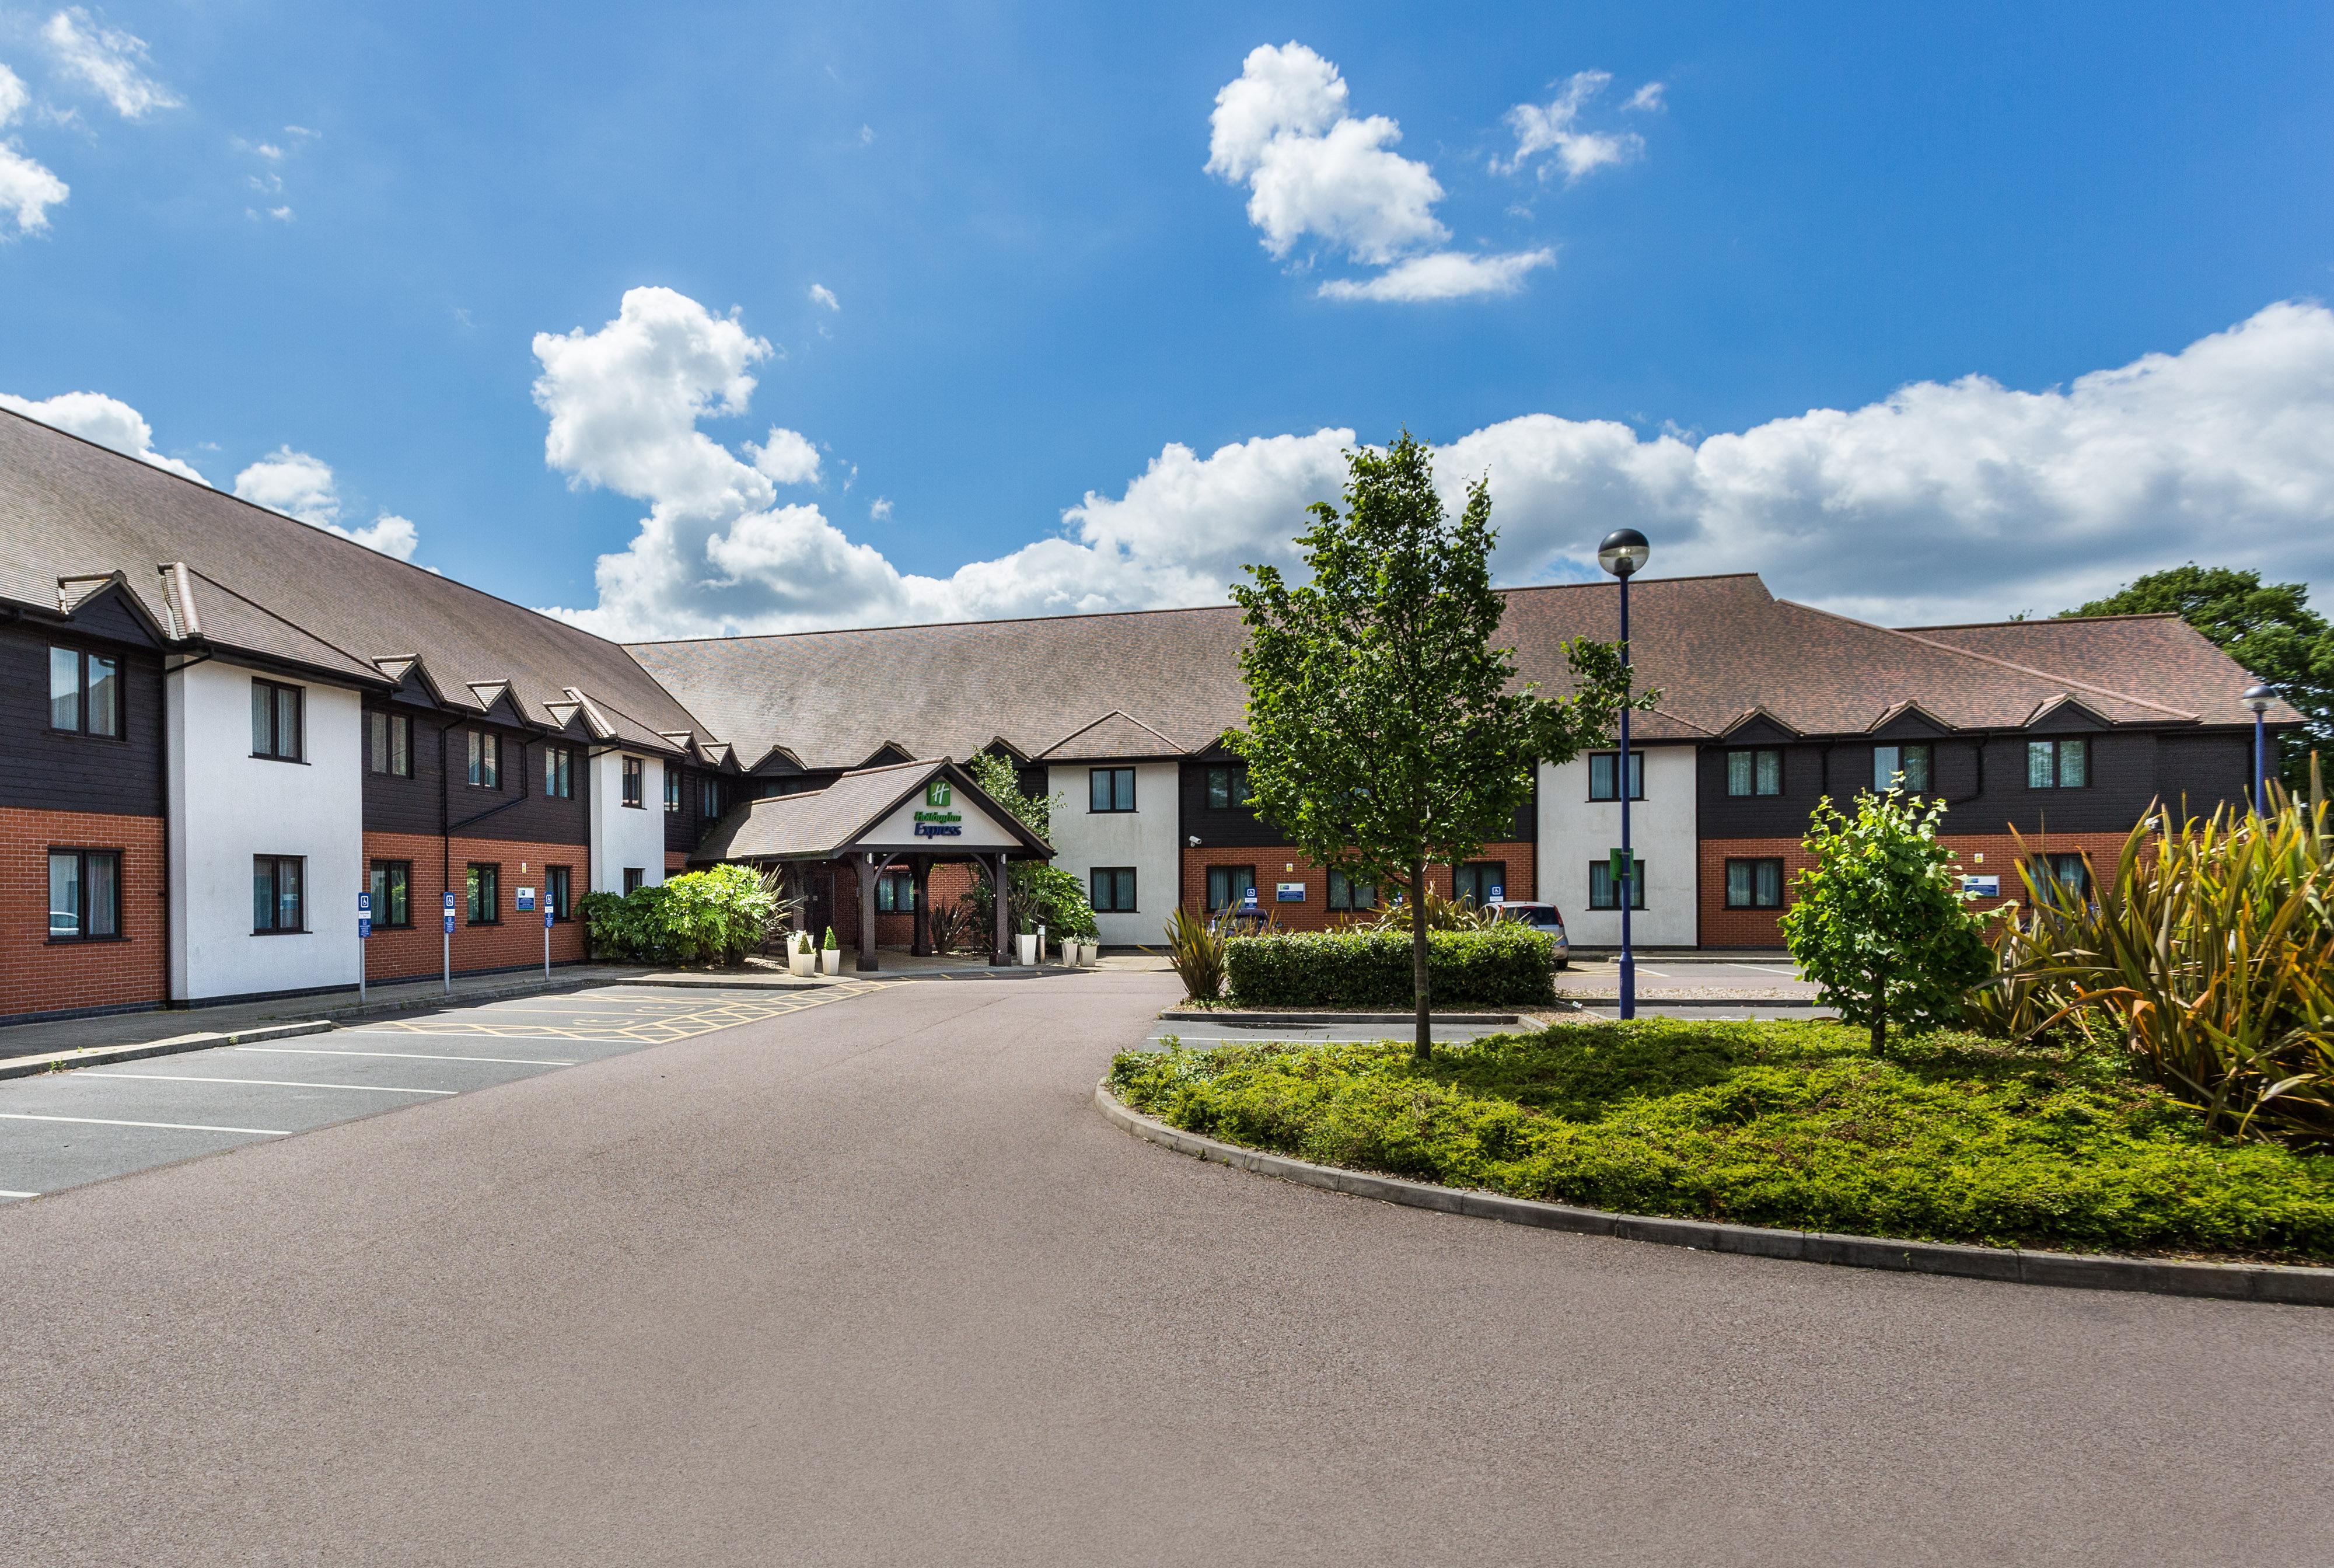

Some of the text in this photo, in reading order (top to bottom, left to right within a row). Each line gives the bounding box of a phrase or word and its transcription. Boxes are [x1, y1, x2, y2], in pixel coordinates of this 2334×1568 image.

[914, 811, 962, 823] Holiday Inn
[914, 822, 962, 839] Express
